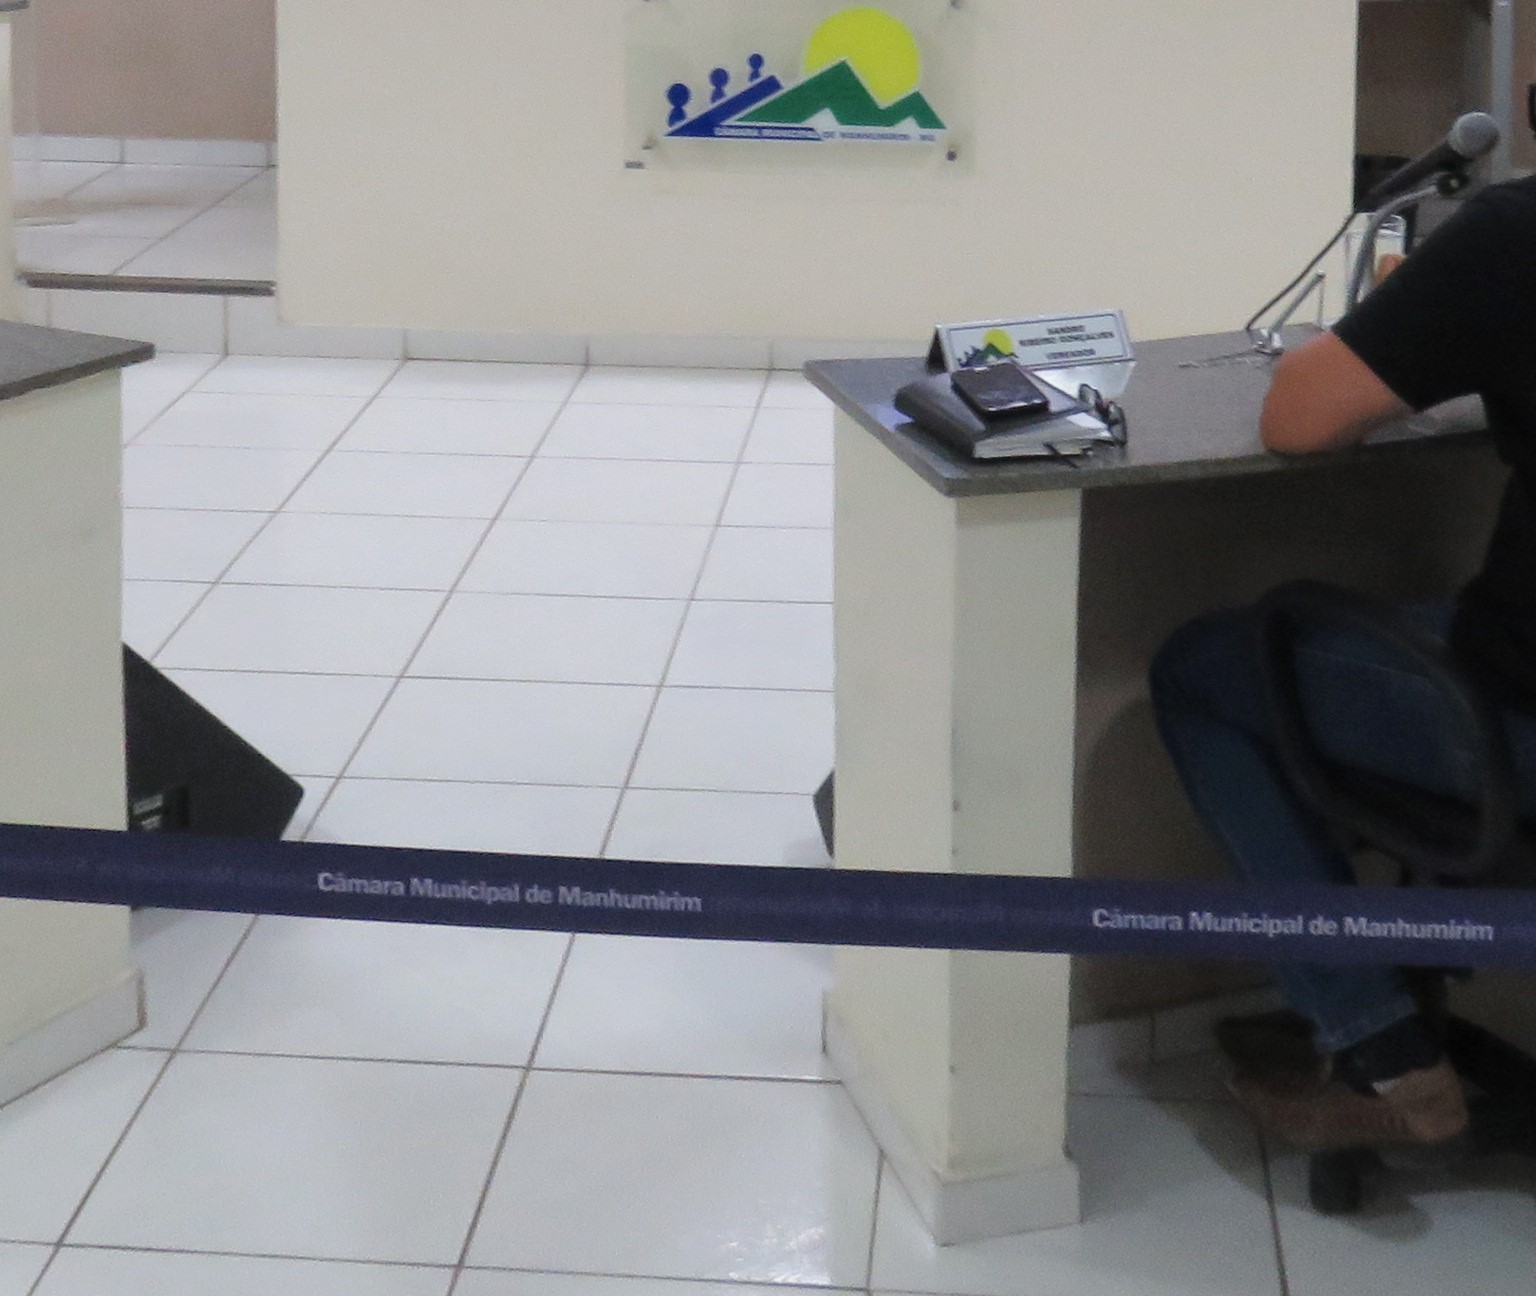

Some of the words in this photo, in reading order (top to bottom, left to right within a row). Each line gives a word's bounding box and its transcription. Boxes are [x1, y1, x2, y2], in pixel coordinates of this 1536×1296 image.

[317, 872, 405, 896] Câmara
[410, 877, 519, 904] Municipal
[525, 884, 553, 904] de
[559, 885, 702, 912] Manhumirim
[1092, 908, 1183, 931] Câmara
[1190, 911, 1303, 937] Municipal
[1309, 915, 1337, 935] de
[1344, 917, 1494, 941] Manhumirim
